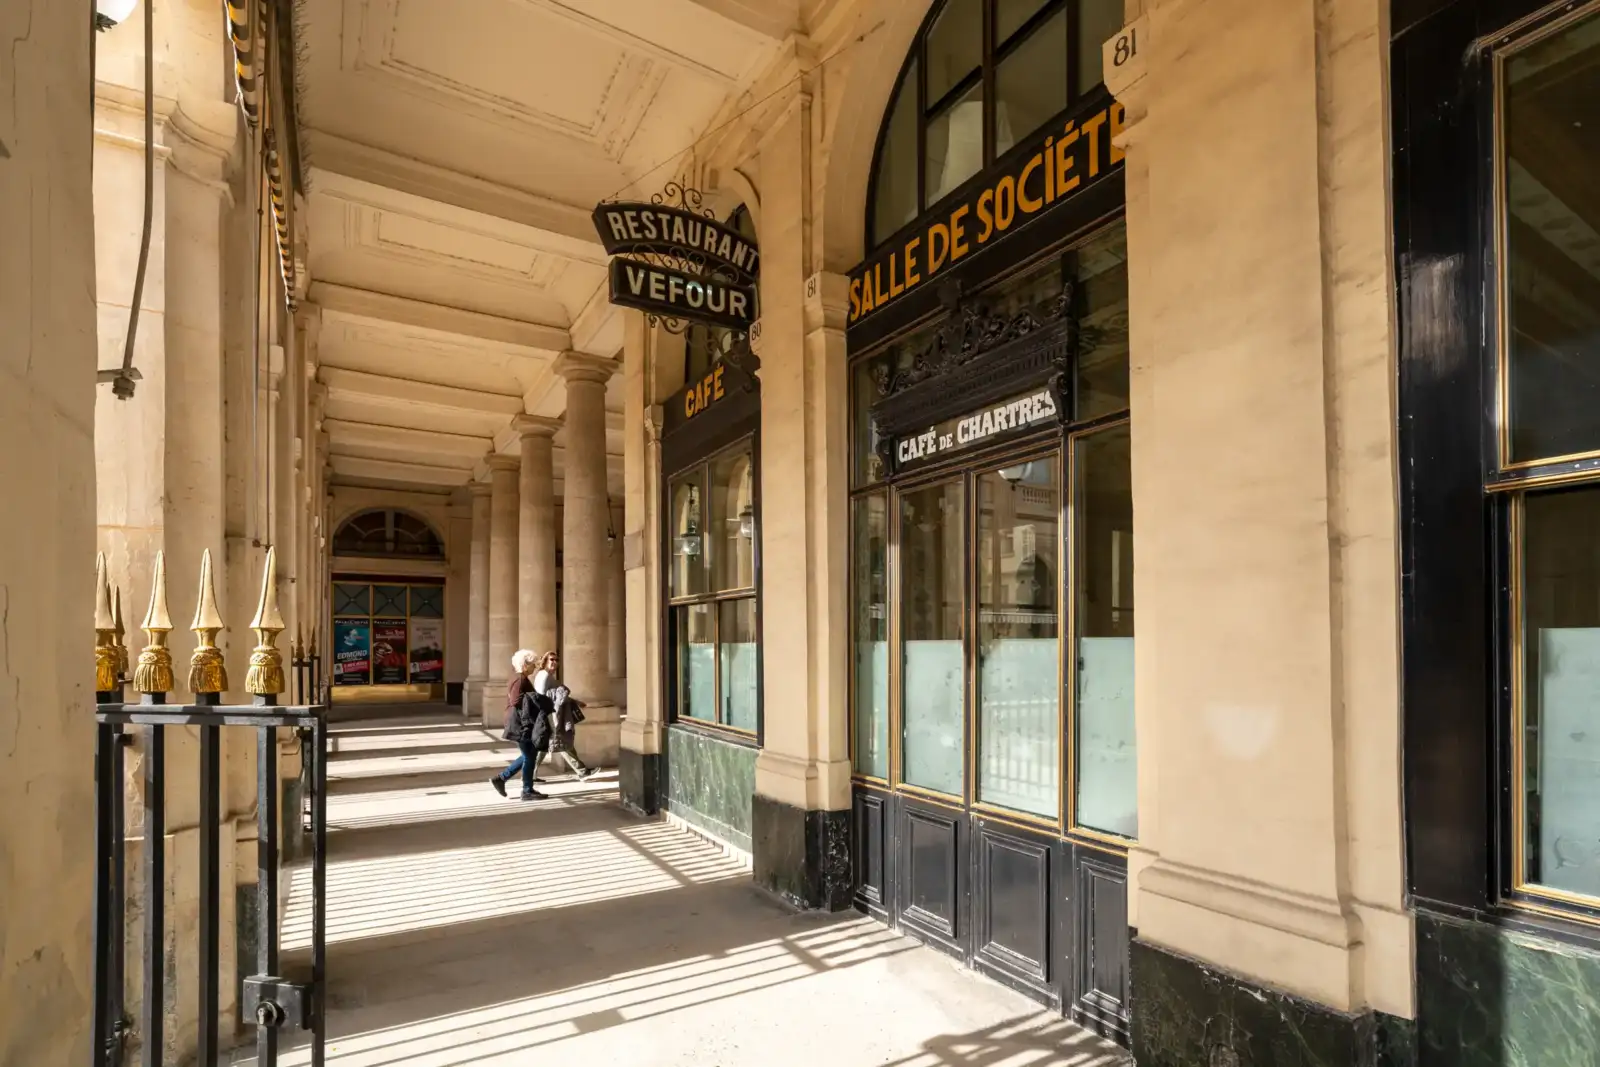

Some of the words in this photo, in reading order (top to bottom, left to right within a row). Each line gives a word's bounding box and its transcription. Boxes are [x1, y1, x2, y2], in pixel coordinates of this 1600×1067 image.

[1113, 27, 1137, 67] 81
[606, 210, 759, 273] RESTAURANT
[849, 236, 920, 322] SALLE
[928, 203, 969, 275] DE
[626, 266, 747, 318] VEFOUR
[807, 277, 816, 298] 81
[685, 363, 725, 419] CAFÉ
[899, 426, 936, 463] CAFÉ
[939, 433, 953, 451] DE
[957, 390, 1057, 444] CHARTRES
[337, 650, 368, 660] EDMOND
